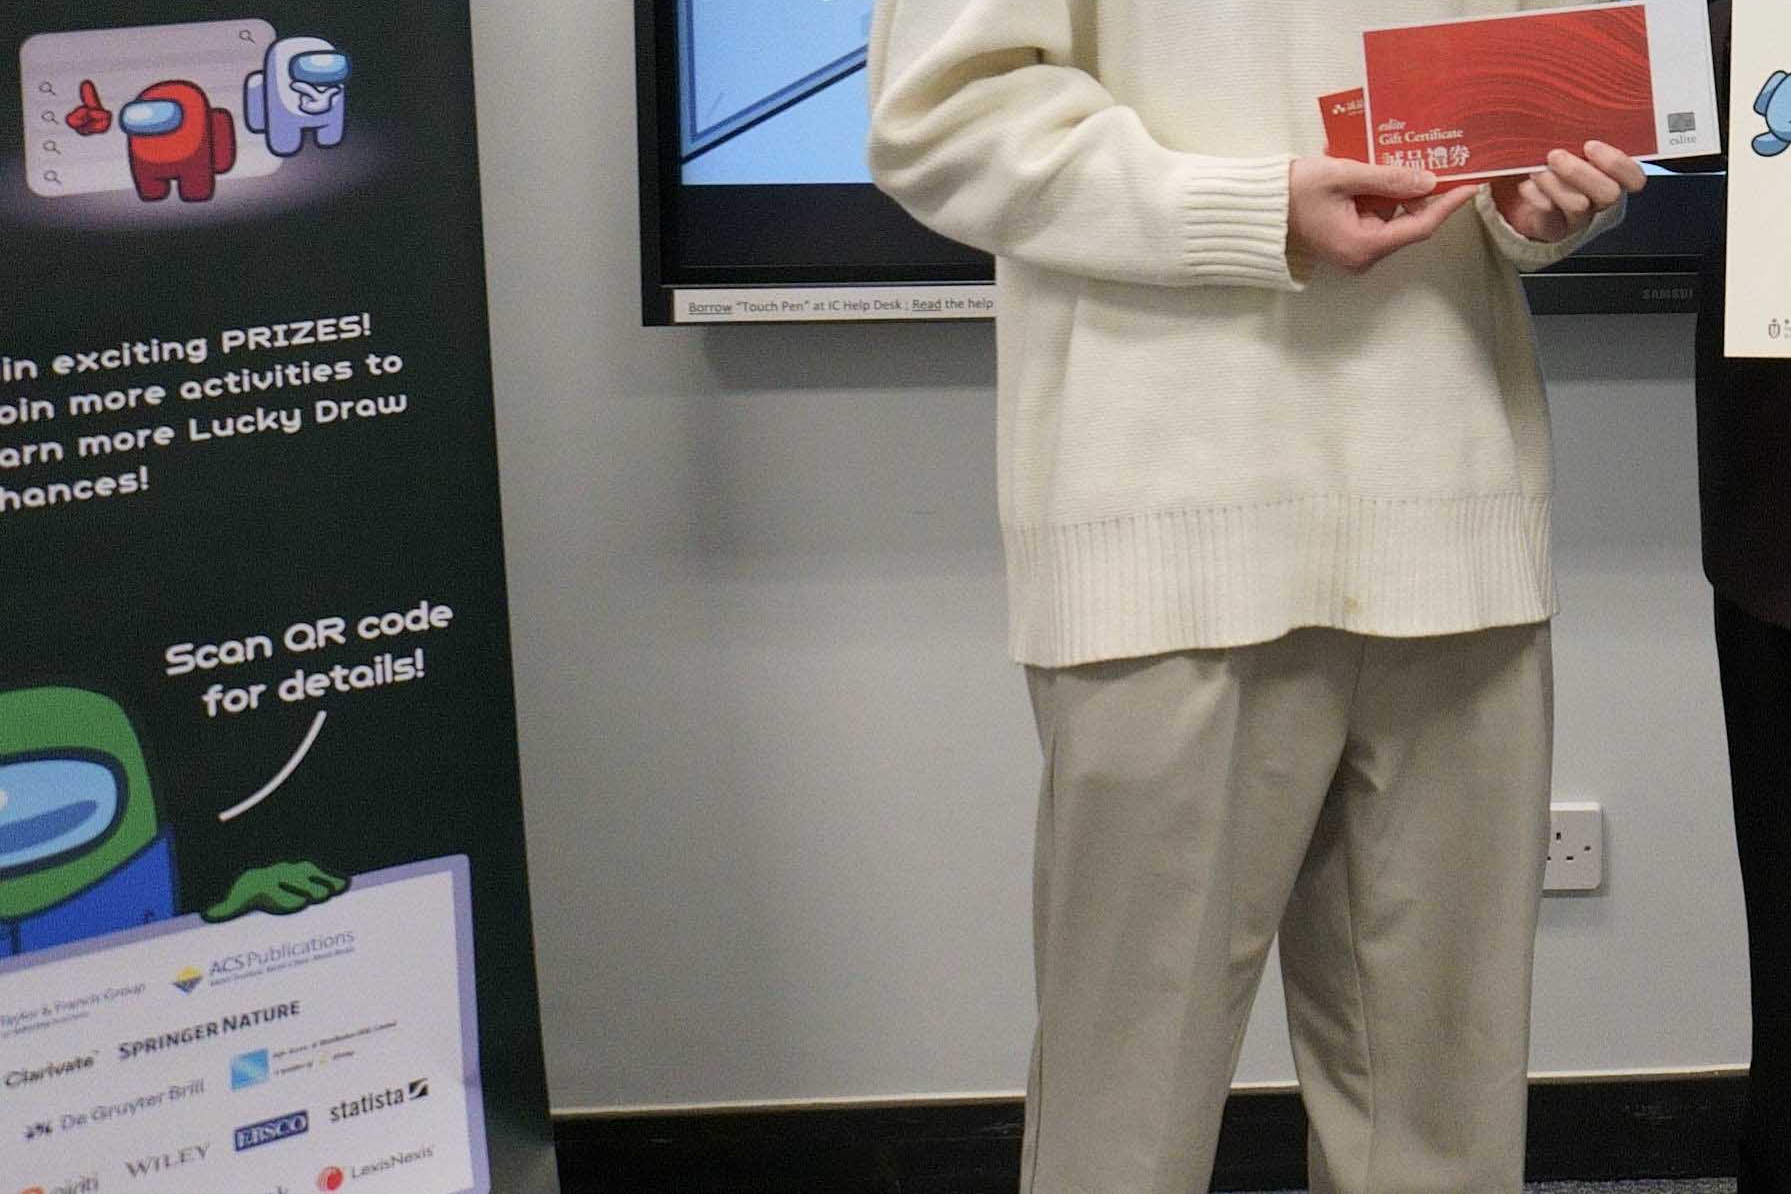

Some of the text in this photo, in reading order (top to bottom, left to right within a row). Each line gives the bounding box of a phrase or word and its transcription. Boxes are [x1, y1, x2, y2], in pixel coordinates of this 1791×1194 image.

[1379, 128, 1464, 146] Gift Certificate
[688, 301, 732, 313] Borrow
[813, 300, 825, 311] at
[828, 300, 840, 311] IC
[843, 298, 871, 314] Help
[874, 298, 902, 311] Desk
[912, 298, 942, 311] Read
[945, 297, 965, 310] the
[967, 296, 994, 311] help
[2, 313, 372, 382] in exciting PRIZES!
[0, 352, 403, 425] oin more activities to
[0, 394, 407, 468] arn more Lucky Draw
[0, 465, 149, 512] hances!
[165, 601, 454, 677] Scan QR code
[201, 648, 425, 717] for details!
[209, 953, 245, 976] ACS
[247, 931, 355, 967] Publications
[118, 1021, 218, 1059] SPRINGER
[222, 1000, 301, 1034] NATURE
[5, 1056, 94, 1087] Clarivate
[60, 1078, 205, 1131] De Gruyter Brill
[329, 1086, 404, 1123] statista
[238, 1114, 305, 1148] EBSCO
[125, 1142, 211, 1178] WILEY
[351, 1146, 434, 1179] LexisNexis
